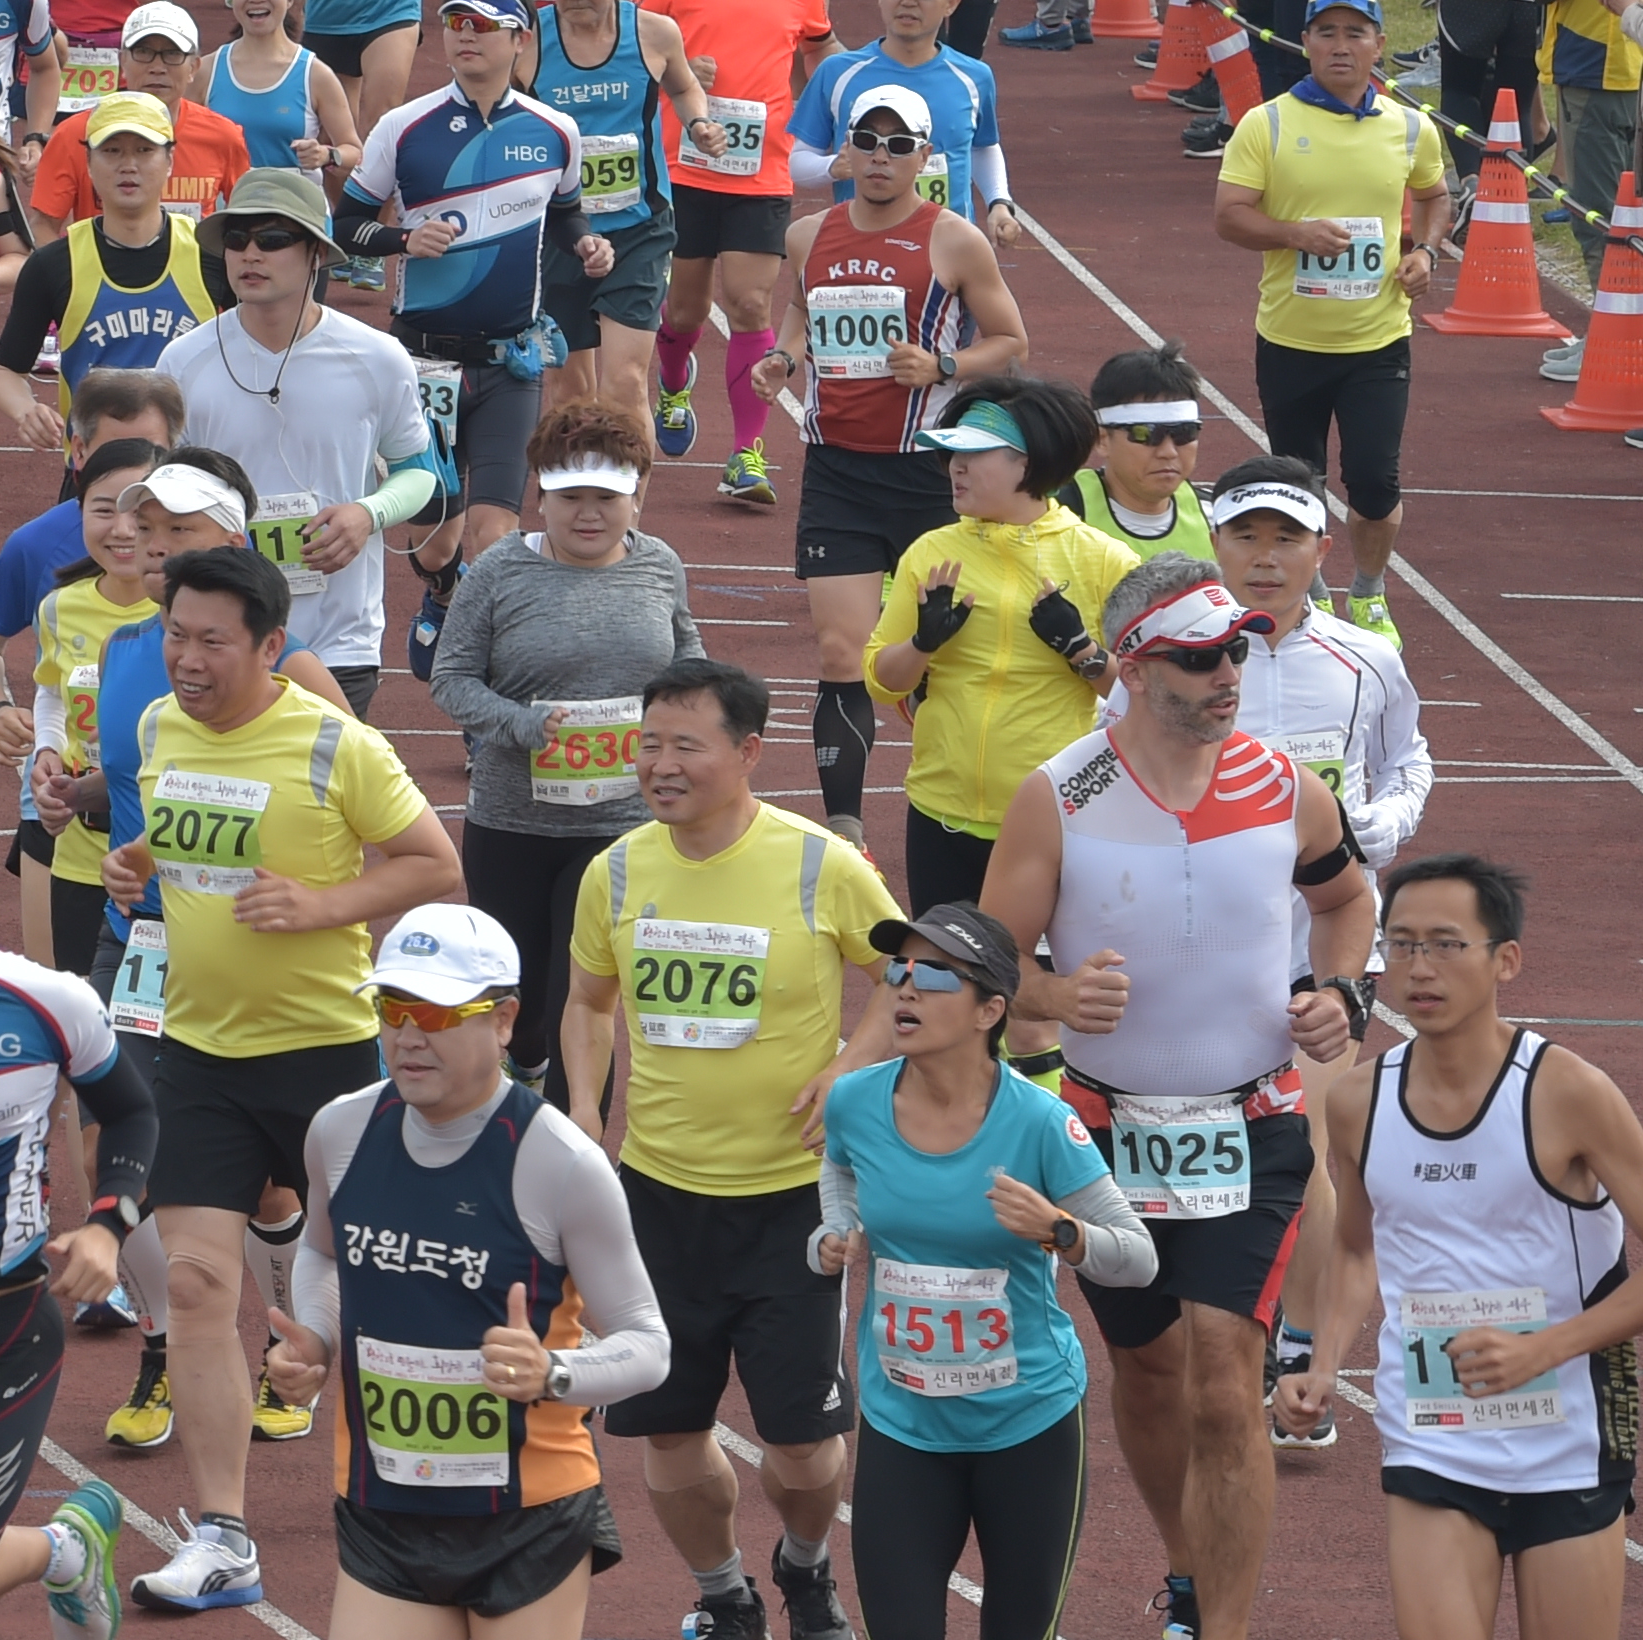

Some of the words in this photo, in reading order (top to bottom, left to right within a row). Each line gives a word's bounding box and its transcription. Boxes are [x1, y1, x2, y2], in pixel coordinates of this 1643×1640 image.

[552, 84, 629, 104] 건달파마
[505, 146, 547, 161] HBG
[828, 260, 896, 281] KRRC
[815, 312, 905, 349] 1006
[1231, 487, 1309, 507] TaylorMade
[1060, 749, 1118, 798] COMPRE
[152, 808, 256, 855] 2077
[635, 957, 757, 1008] 2076
[1120, 1131, 1243, 1176] 1025
[343, 1223, 490, 1288] 강원도청
[881, 1302, 1010, 1354] 1513
[935, 1366, 1012, 1388] 신라면세점
[364, 1382, 501, 1440] 2006
[1417, 1415, 1438, 1423] duty
[1441, 1415, 1461, 1423] free
[1473, 1400, 1554, 1422] 신라면세점
